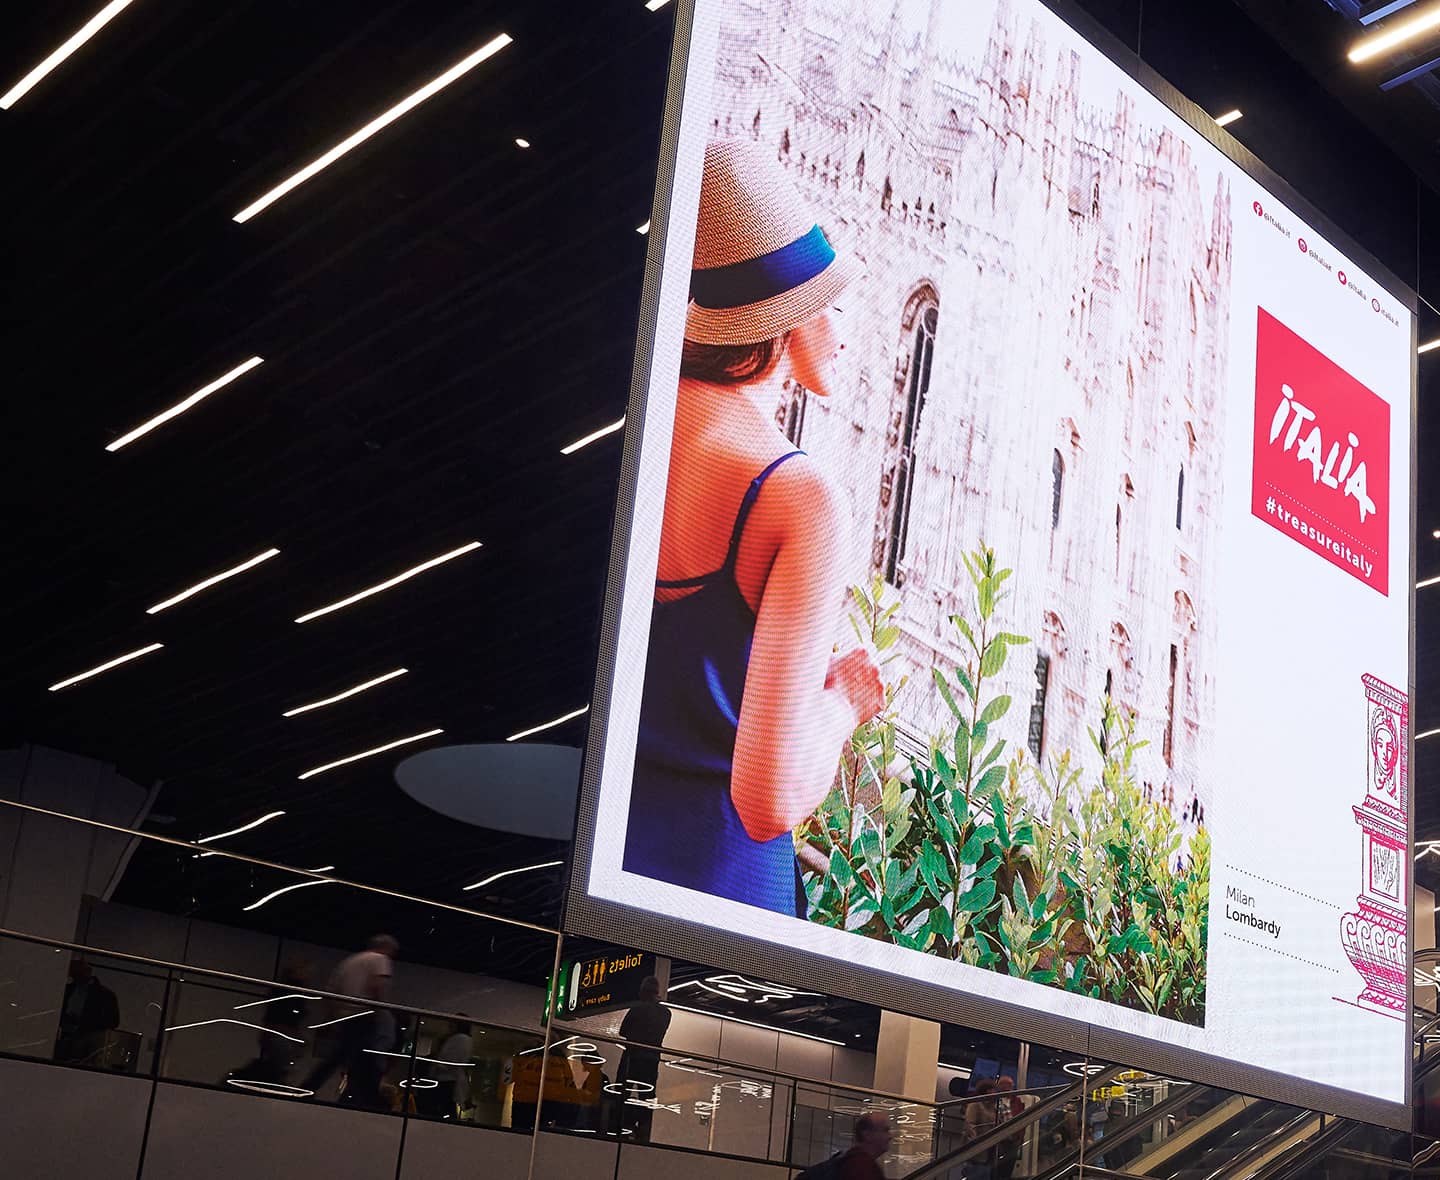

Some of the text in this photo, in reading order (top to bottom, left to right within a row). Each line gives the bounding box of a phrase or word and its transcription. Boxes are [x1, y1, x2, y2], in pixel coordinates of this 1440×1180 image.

[1265, 496, 1374, 578] #treasureitaly
[1226, 885, 1256, 908] Milan
[1226, 904, 1281, 938] Lombardy
